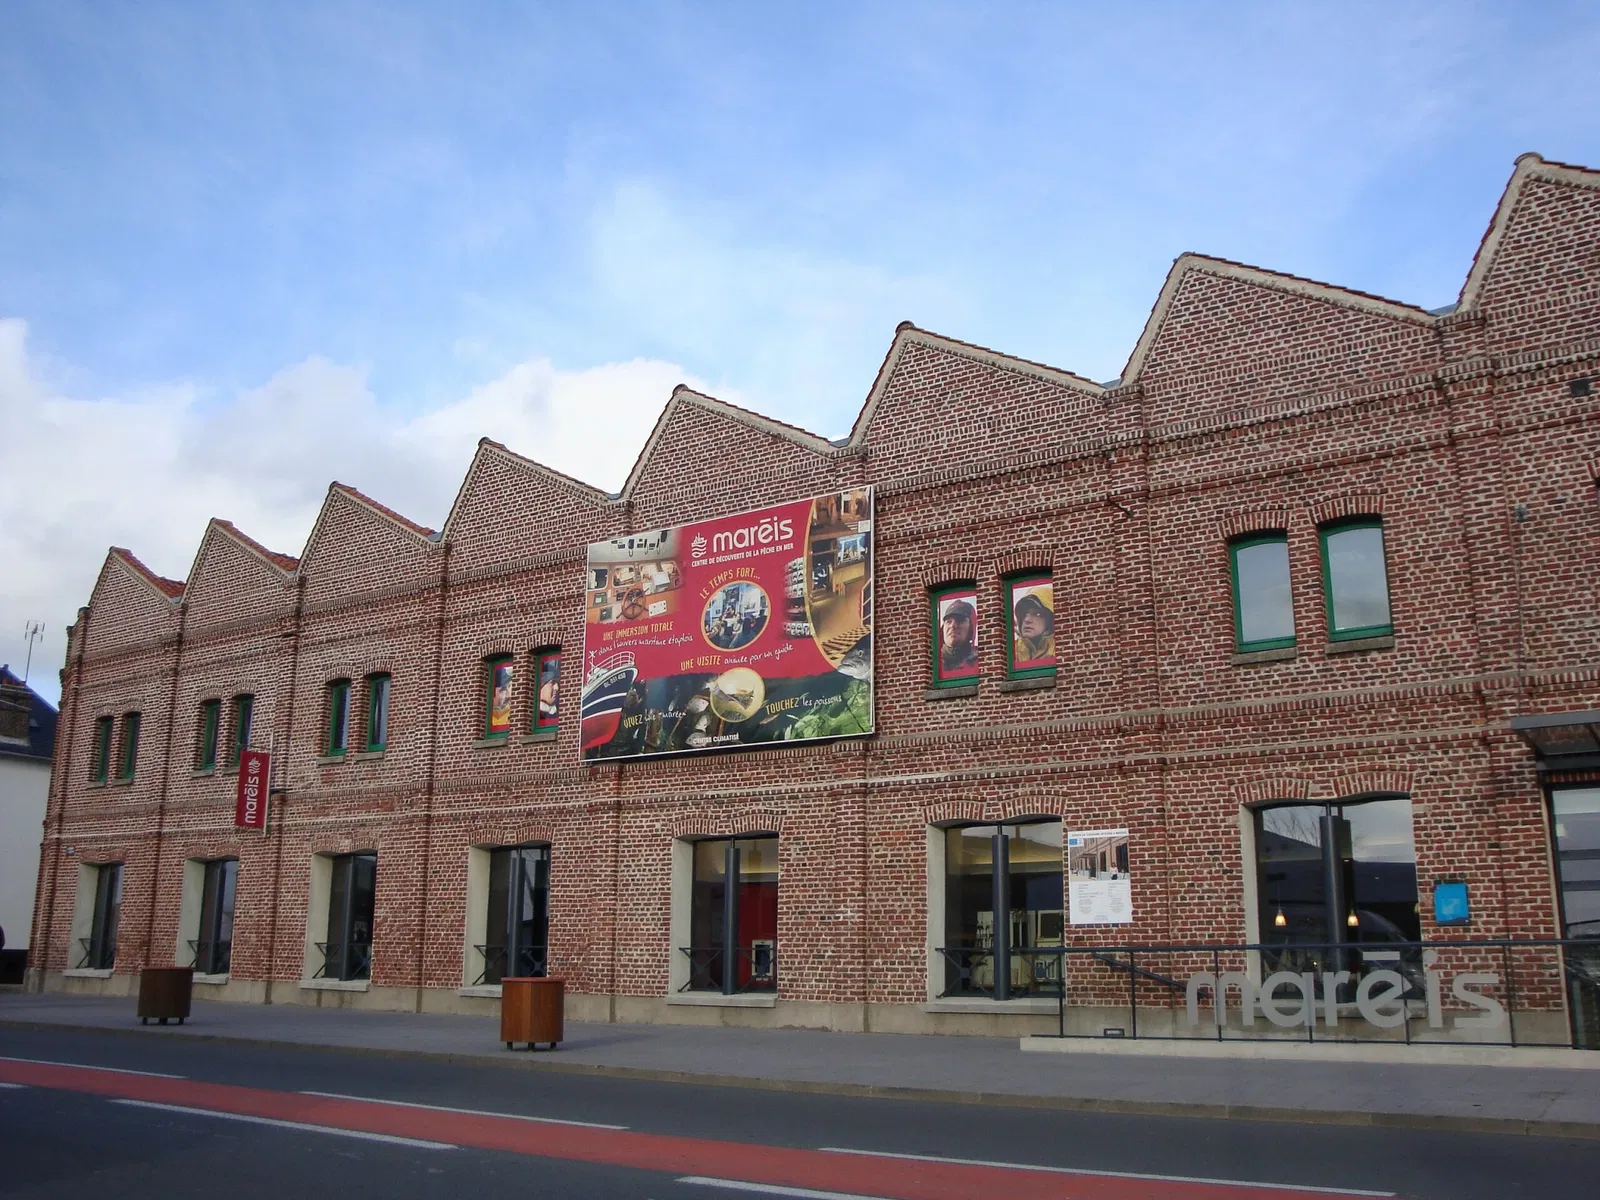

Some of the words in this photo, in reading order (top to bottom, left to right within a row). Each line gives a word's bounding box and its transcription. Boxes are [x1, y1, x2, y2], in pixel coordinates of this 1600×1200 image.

[692, 558, 708, 567] CENTRE
[709, 556, 715, 564] DE
[716, 552, 745, 563] DÉCOUVERTE
[760, 545, 775, 555] PÊCHE
[776, 544, 783, 552] EN
[783, 542, 794, 550] MER
[700, 587, 710, 600] LE
[709, 569, 734, 589] TEMPS
[603, 630, 614, 641] UNE
[616, 624, 649, 639] IMMERSION
[651, 621, 674, 632] TOTALE
[598, 645, 612, 656] dans
[639, 635, 666, 646] maritime
[680, 658, 694, 671] UNE
[696, 655, 722, 667] VISITE
[749, 653, 762, 665] par
[774, 643, 794, 660] guide
[766, 697, 800, 715] TOUCHEZ
[813, 694, 842, 709] poissons
[623, 714, 643, 728] VIVEZ
